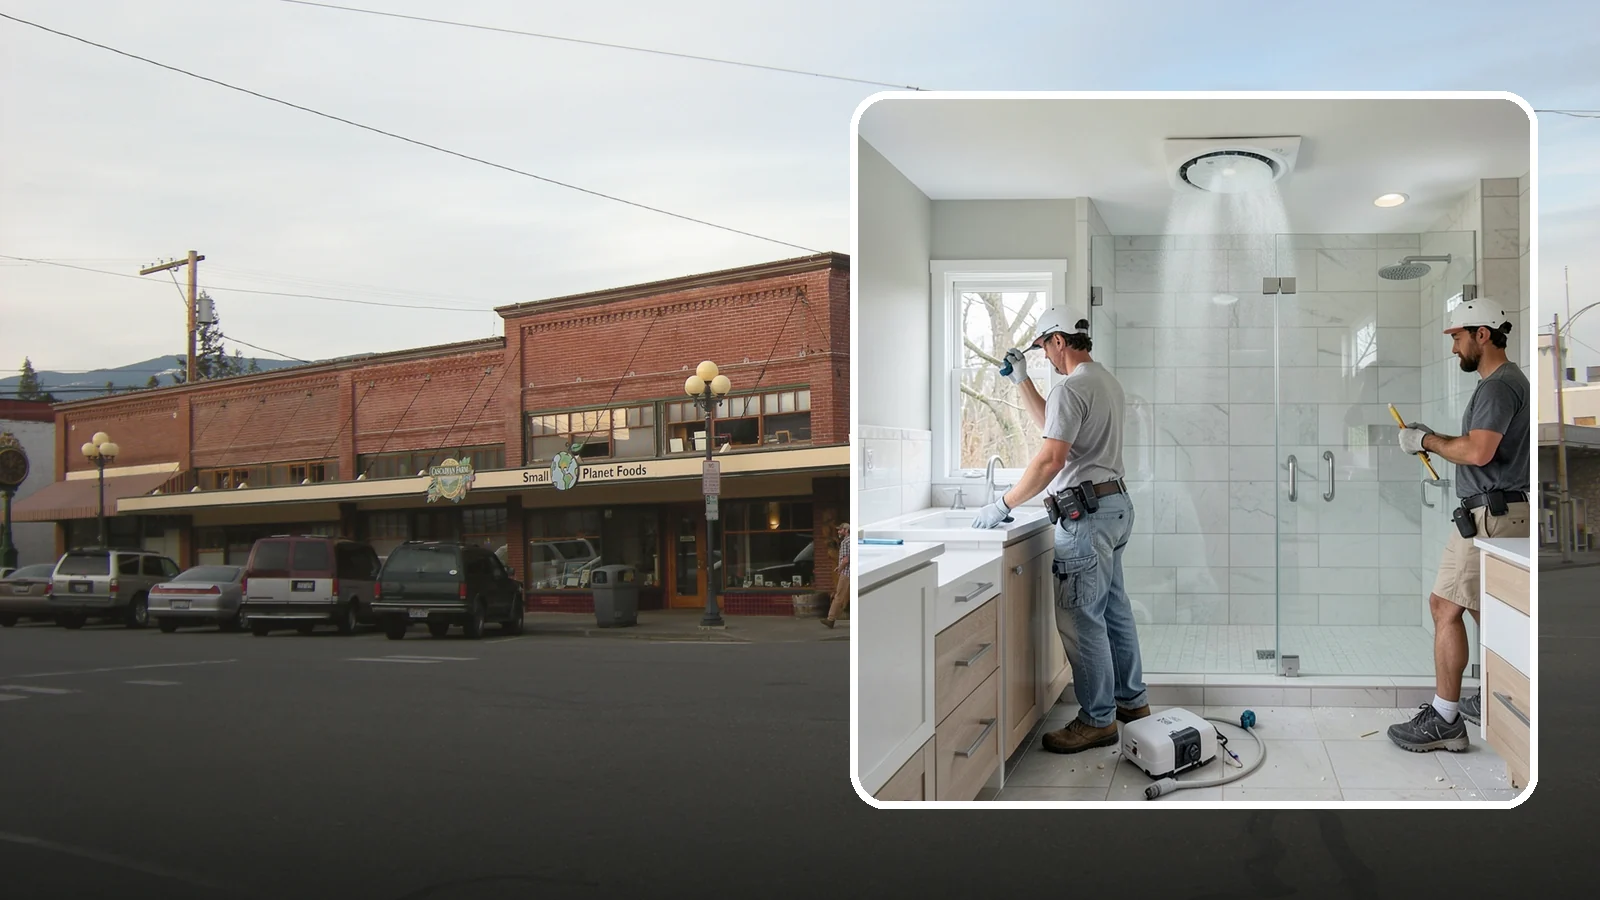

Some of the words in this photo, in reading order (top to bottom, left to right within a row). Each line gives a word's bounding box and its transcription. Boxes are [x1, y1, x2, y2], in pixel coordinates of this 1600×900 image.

[523, 471, 549, 483] Small
[582, 468, 614, 479] Planet
[617, 464, 647, 477] Foods
